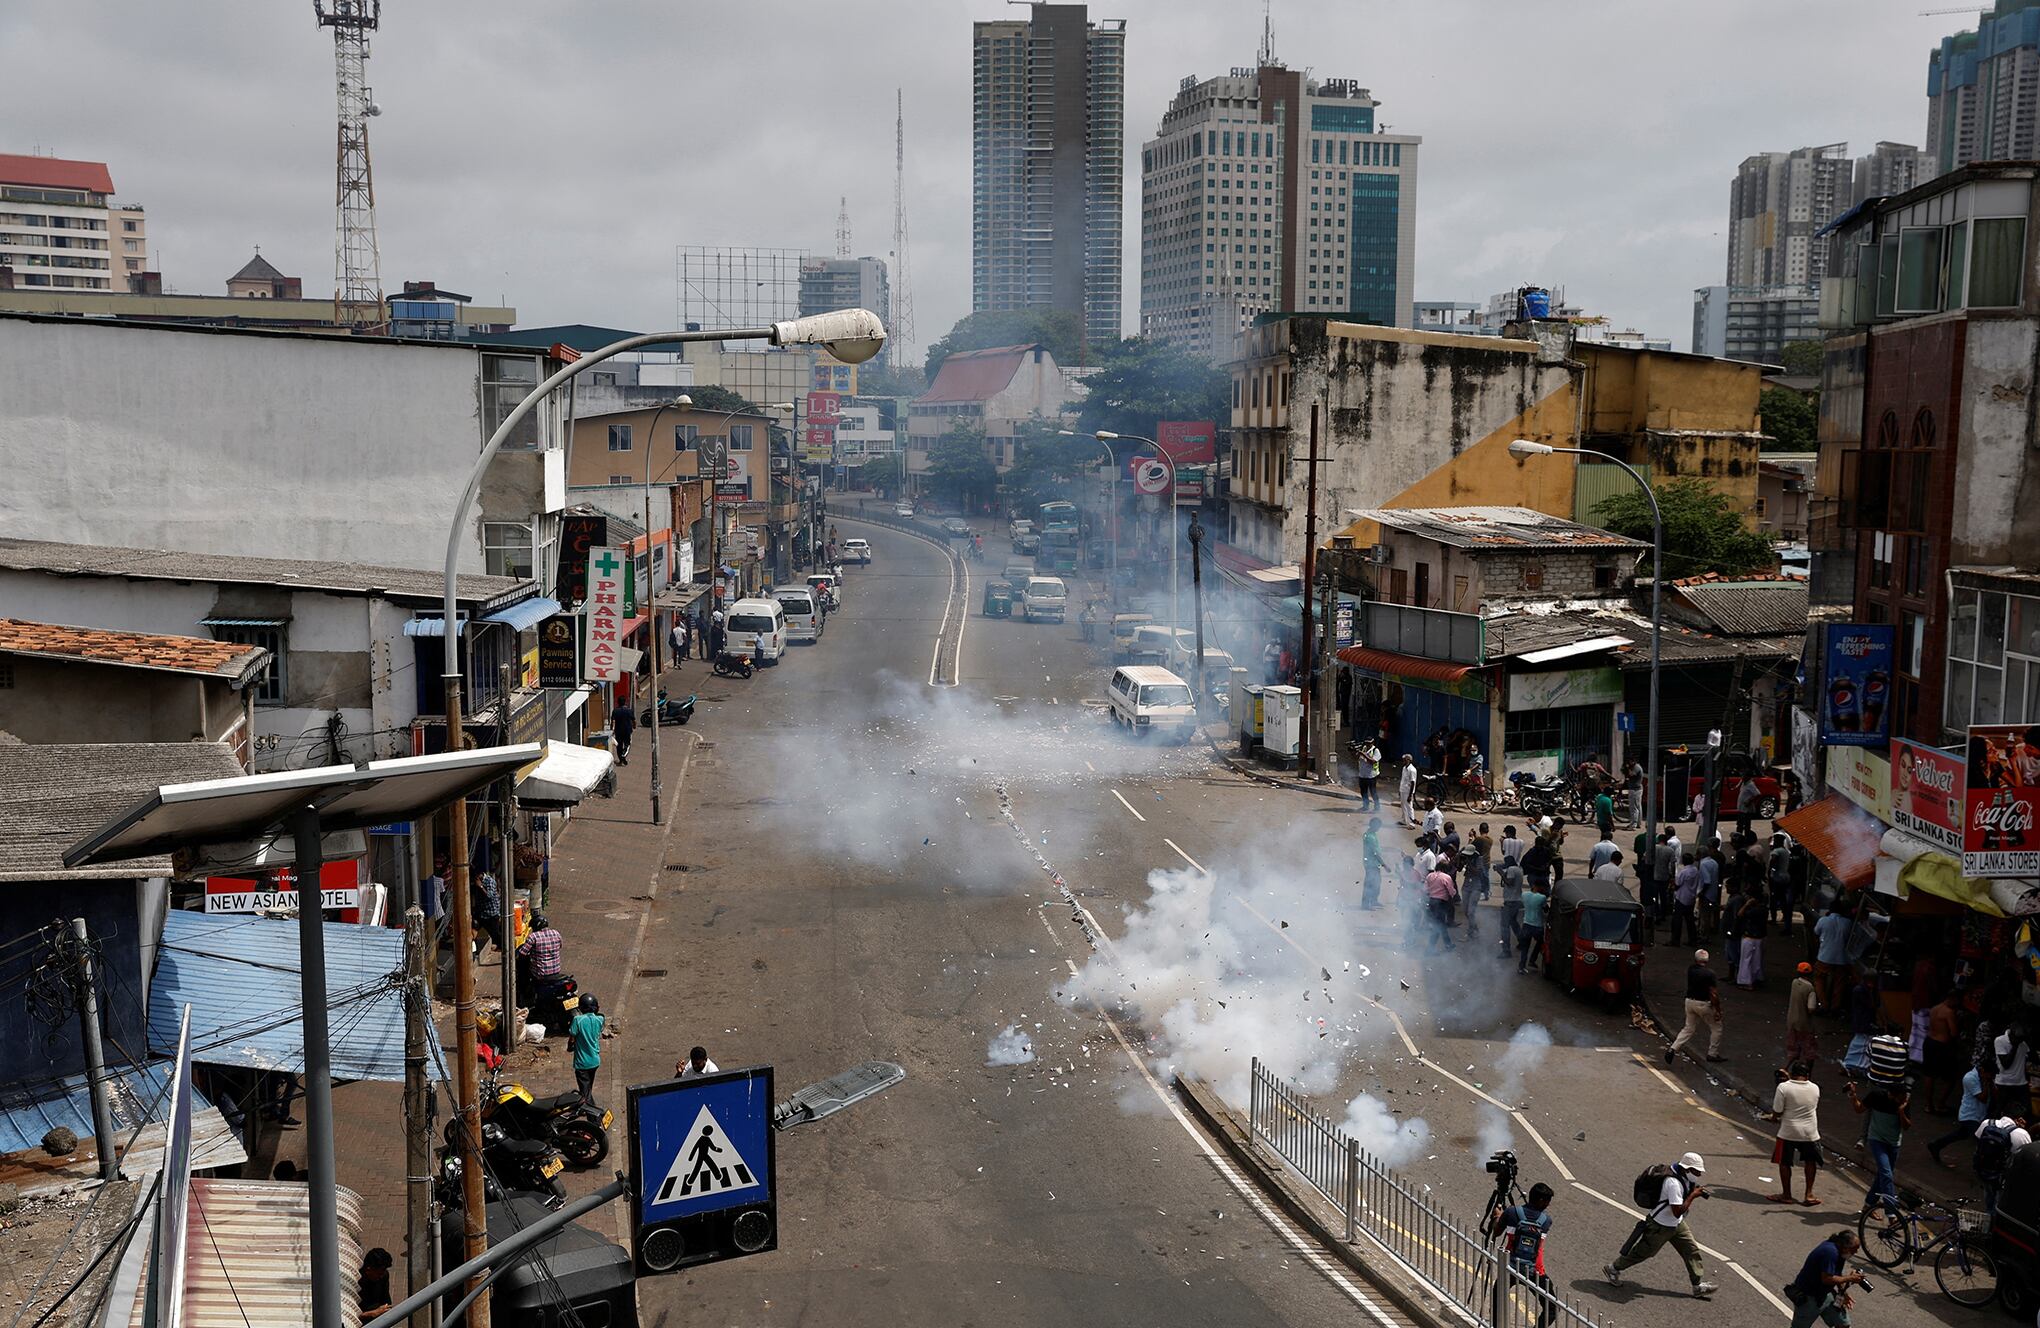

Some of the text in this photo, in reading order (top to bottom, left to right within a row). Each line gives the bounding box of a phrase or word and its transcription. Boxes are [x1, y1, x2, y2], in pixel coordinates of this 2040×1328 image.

[1327, 78, 1358, 93] HNB
[809, 398, 838, 414] LB
[592, 580, 617, 678] PHARMACY
[541, 647, 574, 658] Pawning
[543, 659, 573, 669] Service
[1916, 757, 1954, 792] Velvet
[1973, 800, 2033, 831] Coca-Cola
[1894, 810, 1911, 828] SRI
[1913, 816, 1945, 841] LANKA
[1964, 852, 2038, 870] SRI LANKA STORES
[282, 874, 298, 883] Mag
[210, 894, 248, 910] NEW
[252, 891, 298, 909] ASIAN
